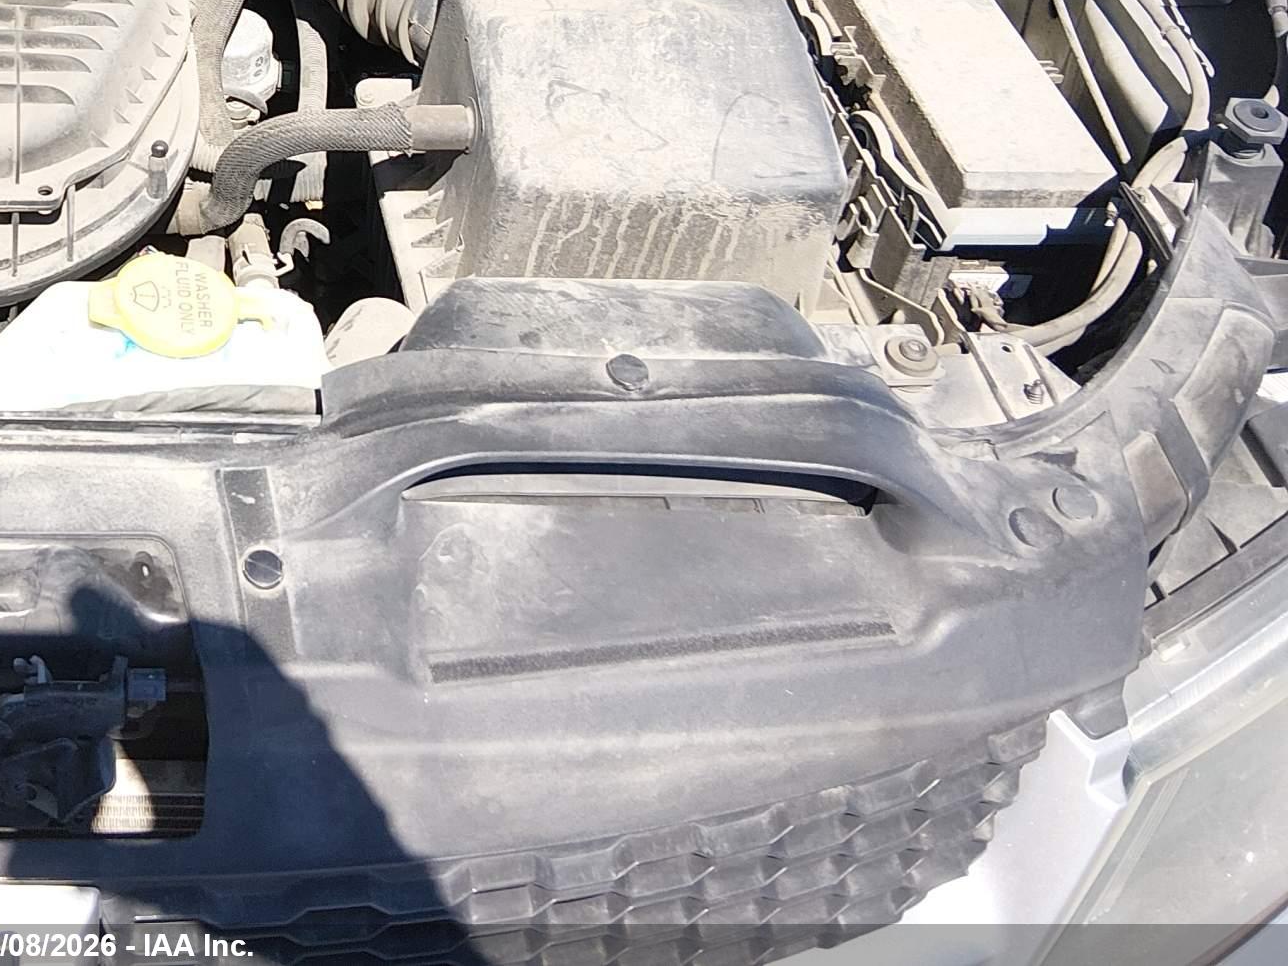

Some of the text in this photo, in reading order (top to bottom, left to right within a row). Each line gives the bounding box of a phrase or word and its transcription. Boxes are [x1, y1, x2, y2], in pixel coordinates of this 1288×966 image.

[175, 261, 195, 336] FLUID ONLY
[194, 273, 214, 328] WASHER
